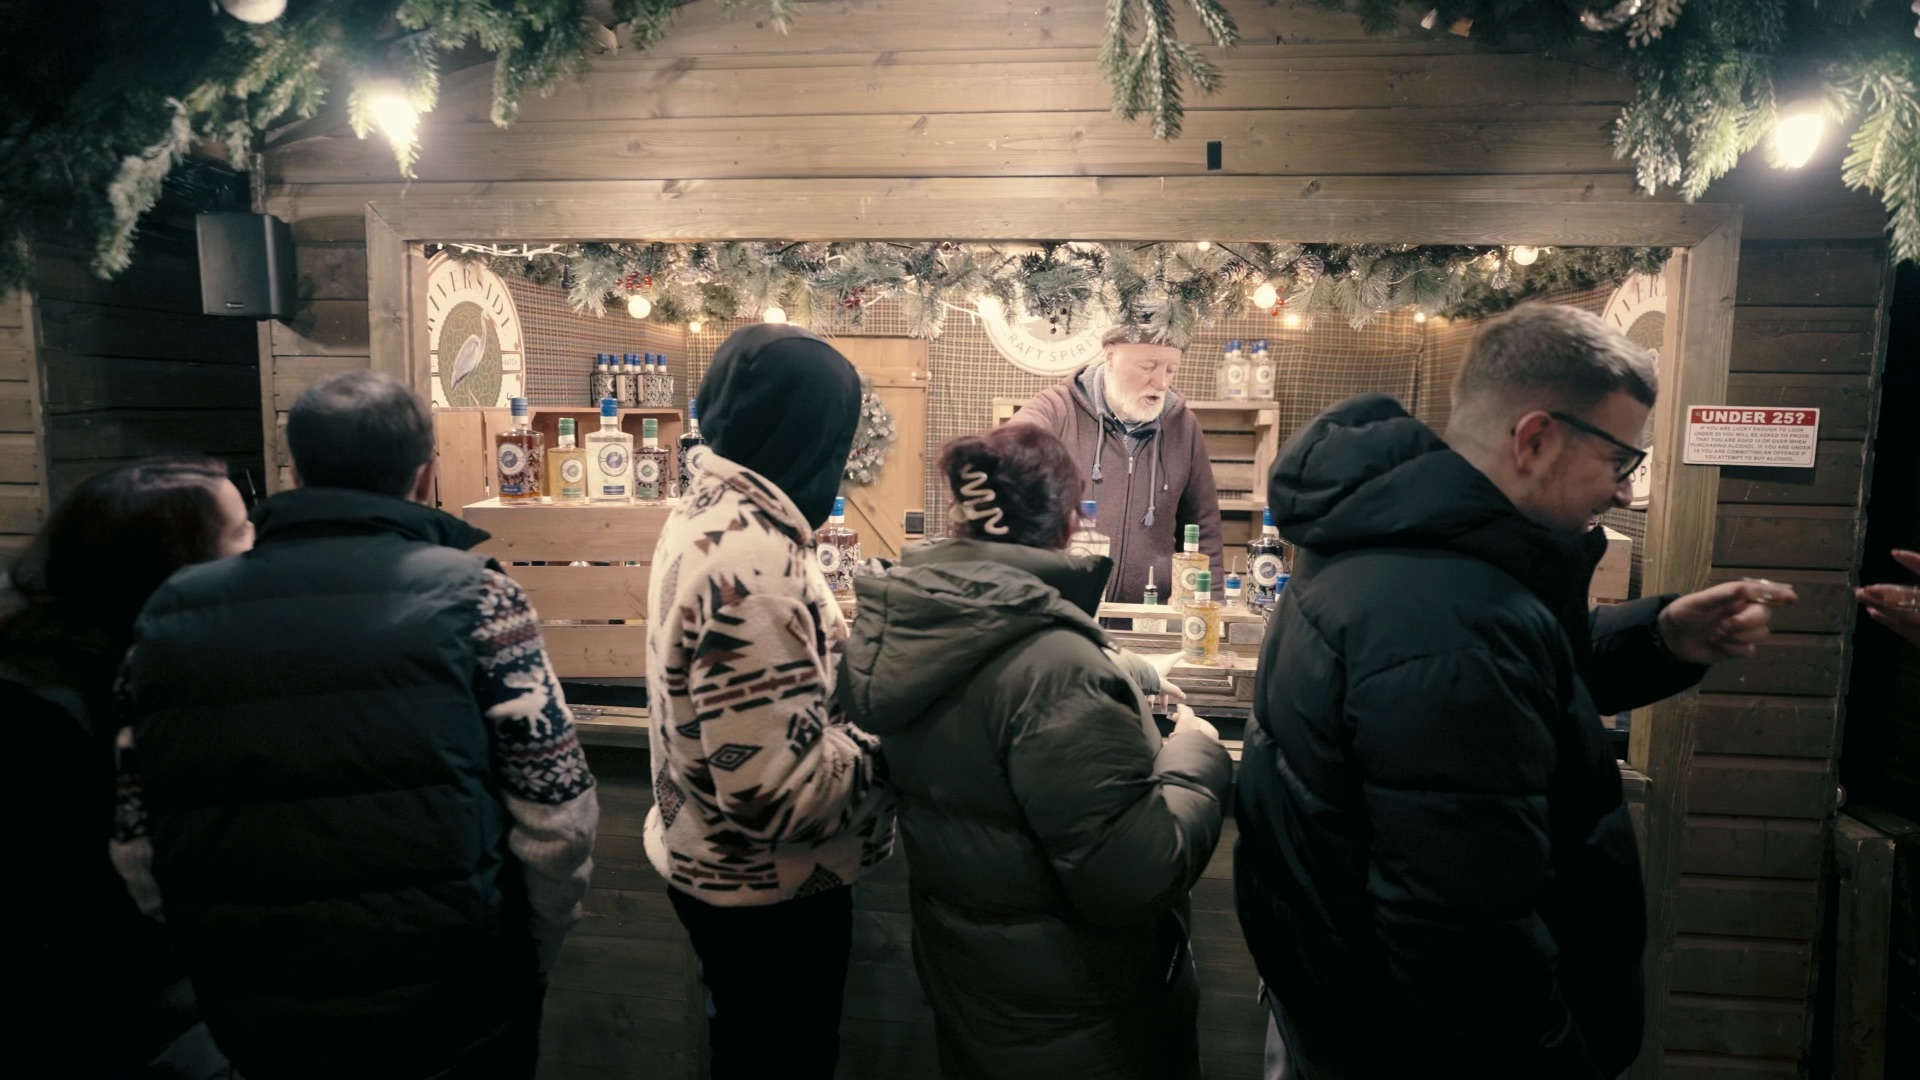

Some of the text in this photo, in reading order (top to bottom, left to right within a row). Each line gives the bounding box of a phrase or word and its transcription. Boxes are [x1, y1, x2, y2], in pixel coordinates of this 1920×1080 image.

[1007, 326, 1104, 363] RAFT SPIRIT
[1701, 410, 1806, 425] UNDER 25?
